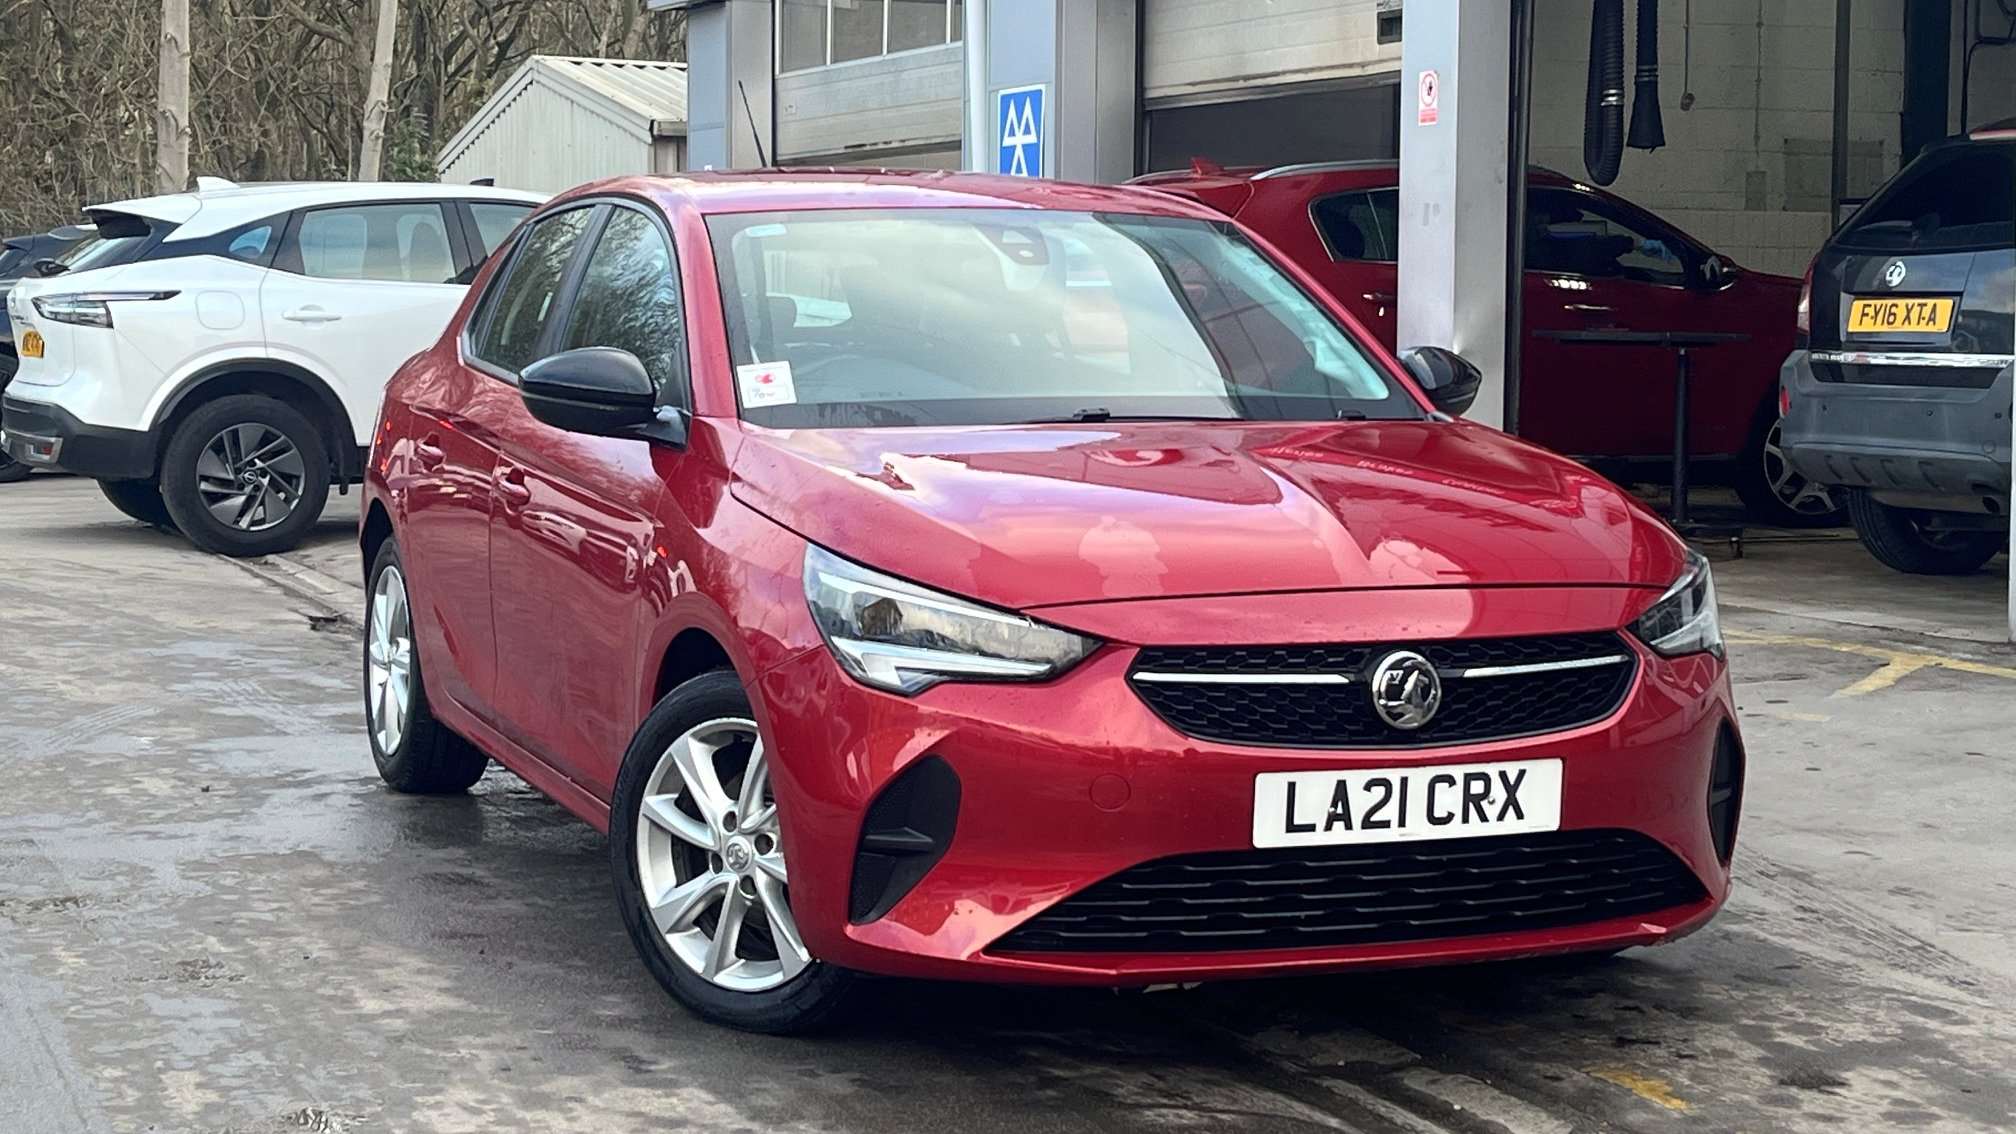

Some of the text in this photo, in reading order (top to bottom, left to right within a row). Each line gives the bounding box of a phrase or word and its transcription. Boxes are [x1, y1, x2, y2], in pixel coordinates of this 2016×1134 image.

[1859, 302, 1937, 327] FY16 XTA
[1285, 768, 1528, 834] LA21 CRX
